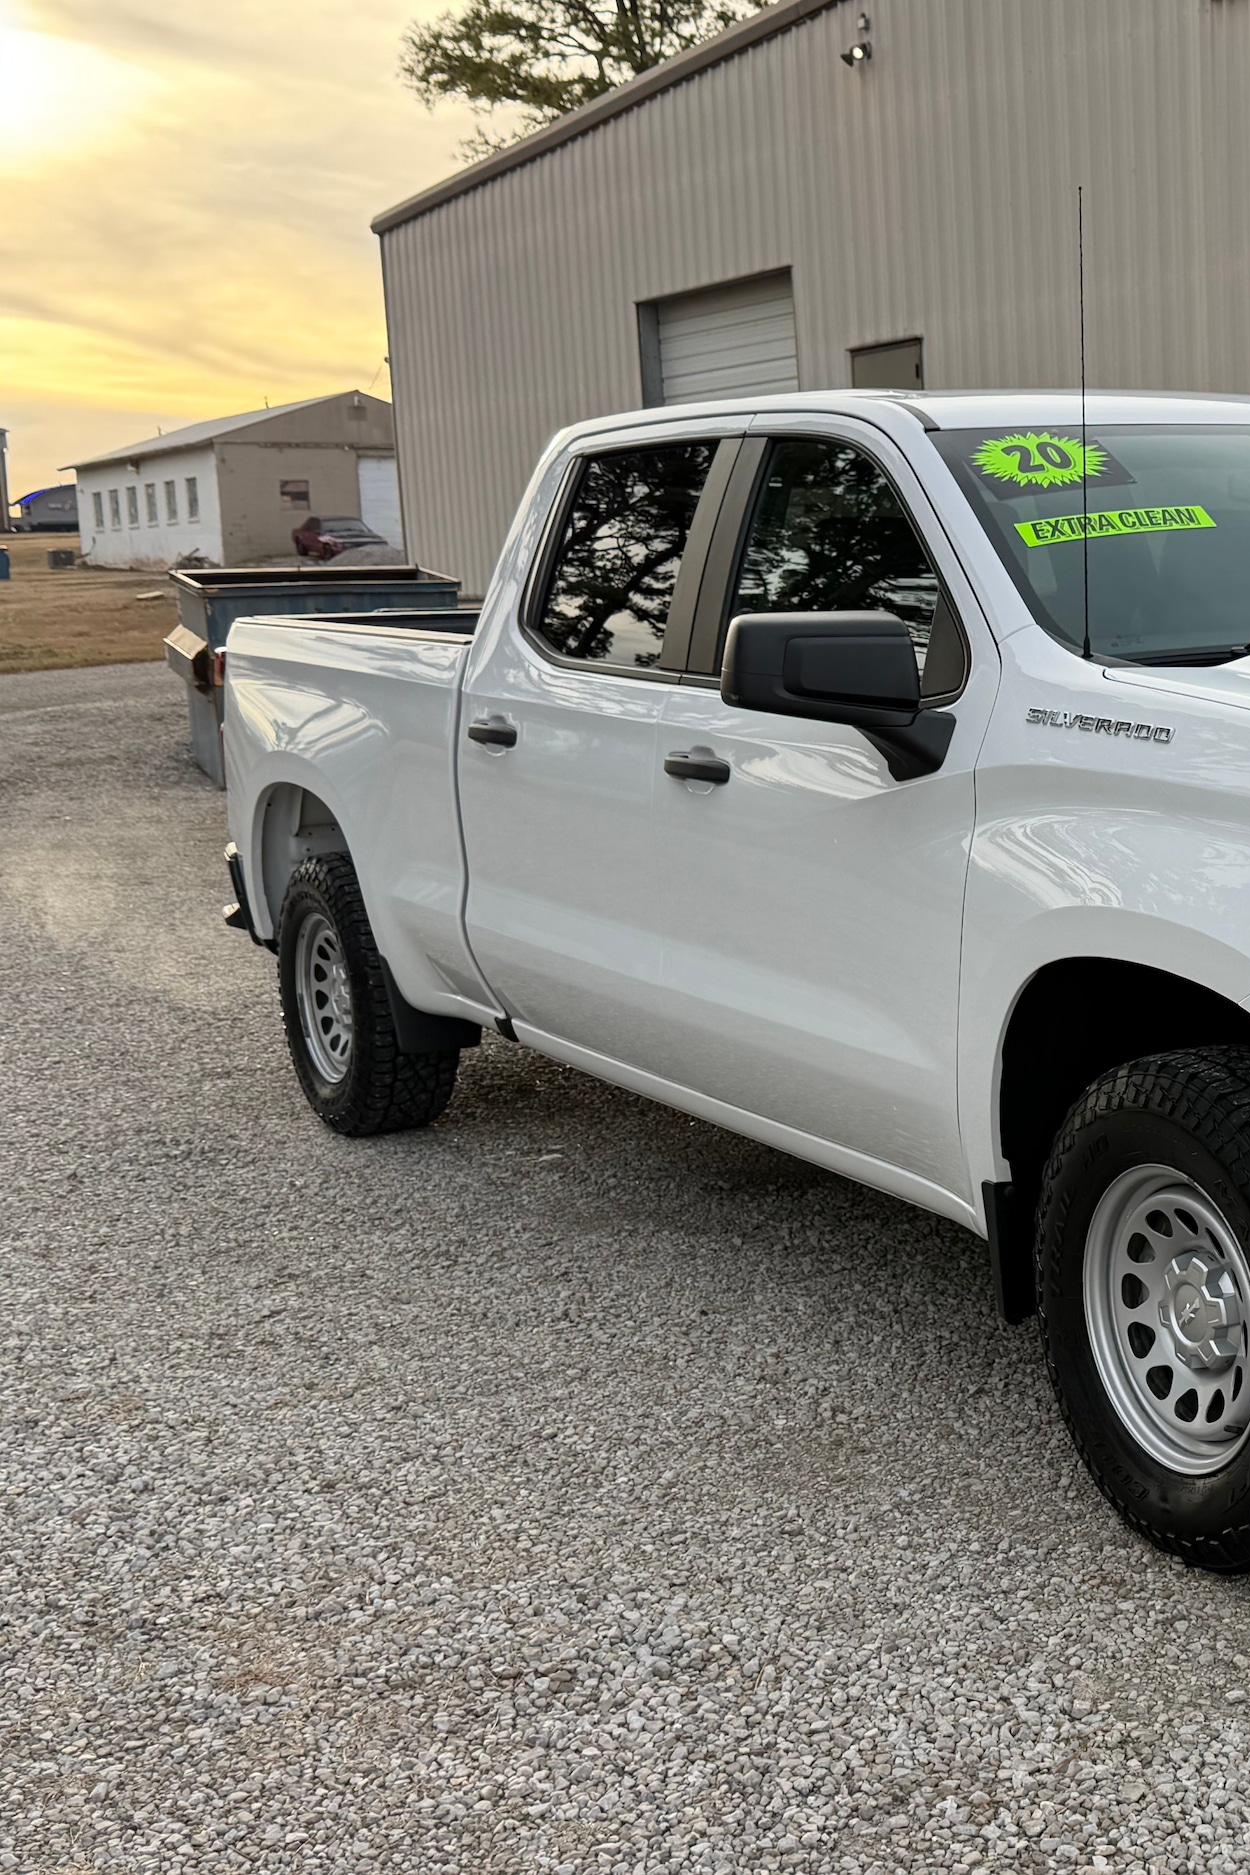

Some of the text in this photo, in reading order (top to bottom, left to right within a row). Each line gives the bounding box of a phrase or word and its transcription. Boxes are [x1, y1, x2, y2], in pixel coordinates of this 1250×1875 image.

[1001, 441, 1074, 474] 20
[1030, 507, 1199, 542] EXTRA CLEAN
[1026, 707, 1176, 744] SILVERADO
